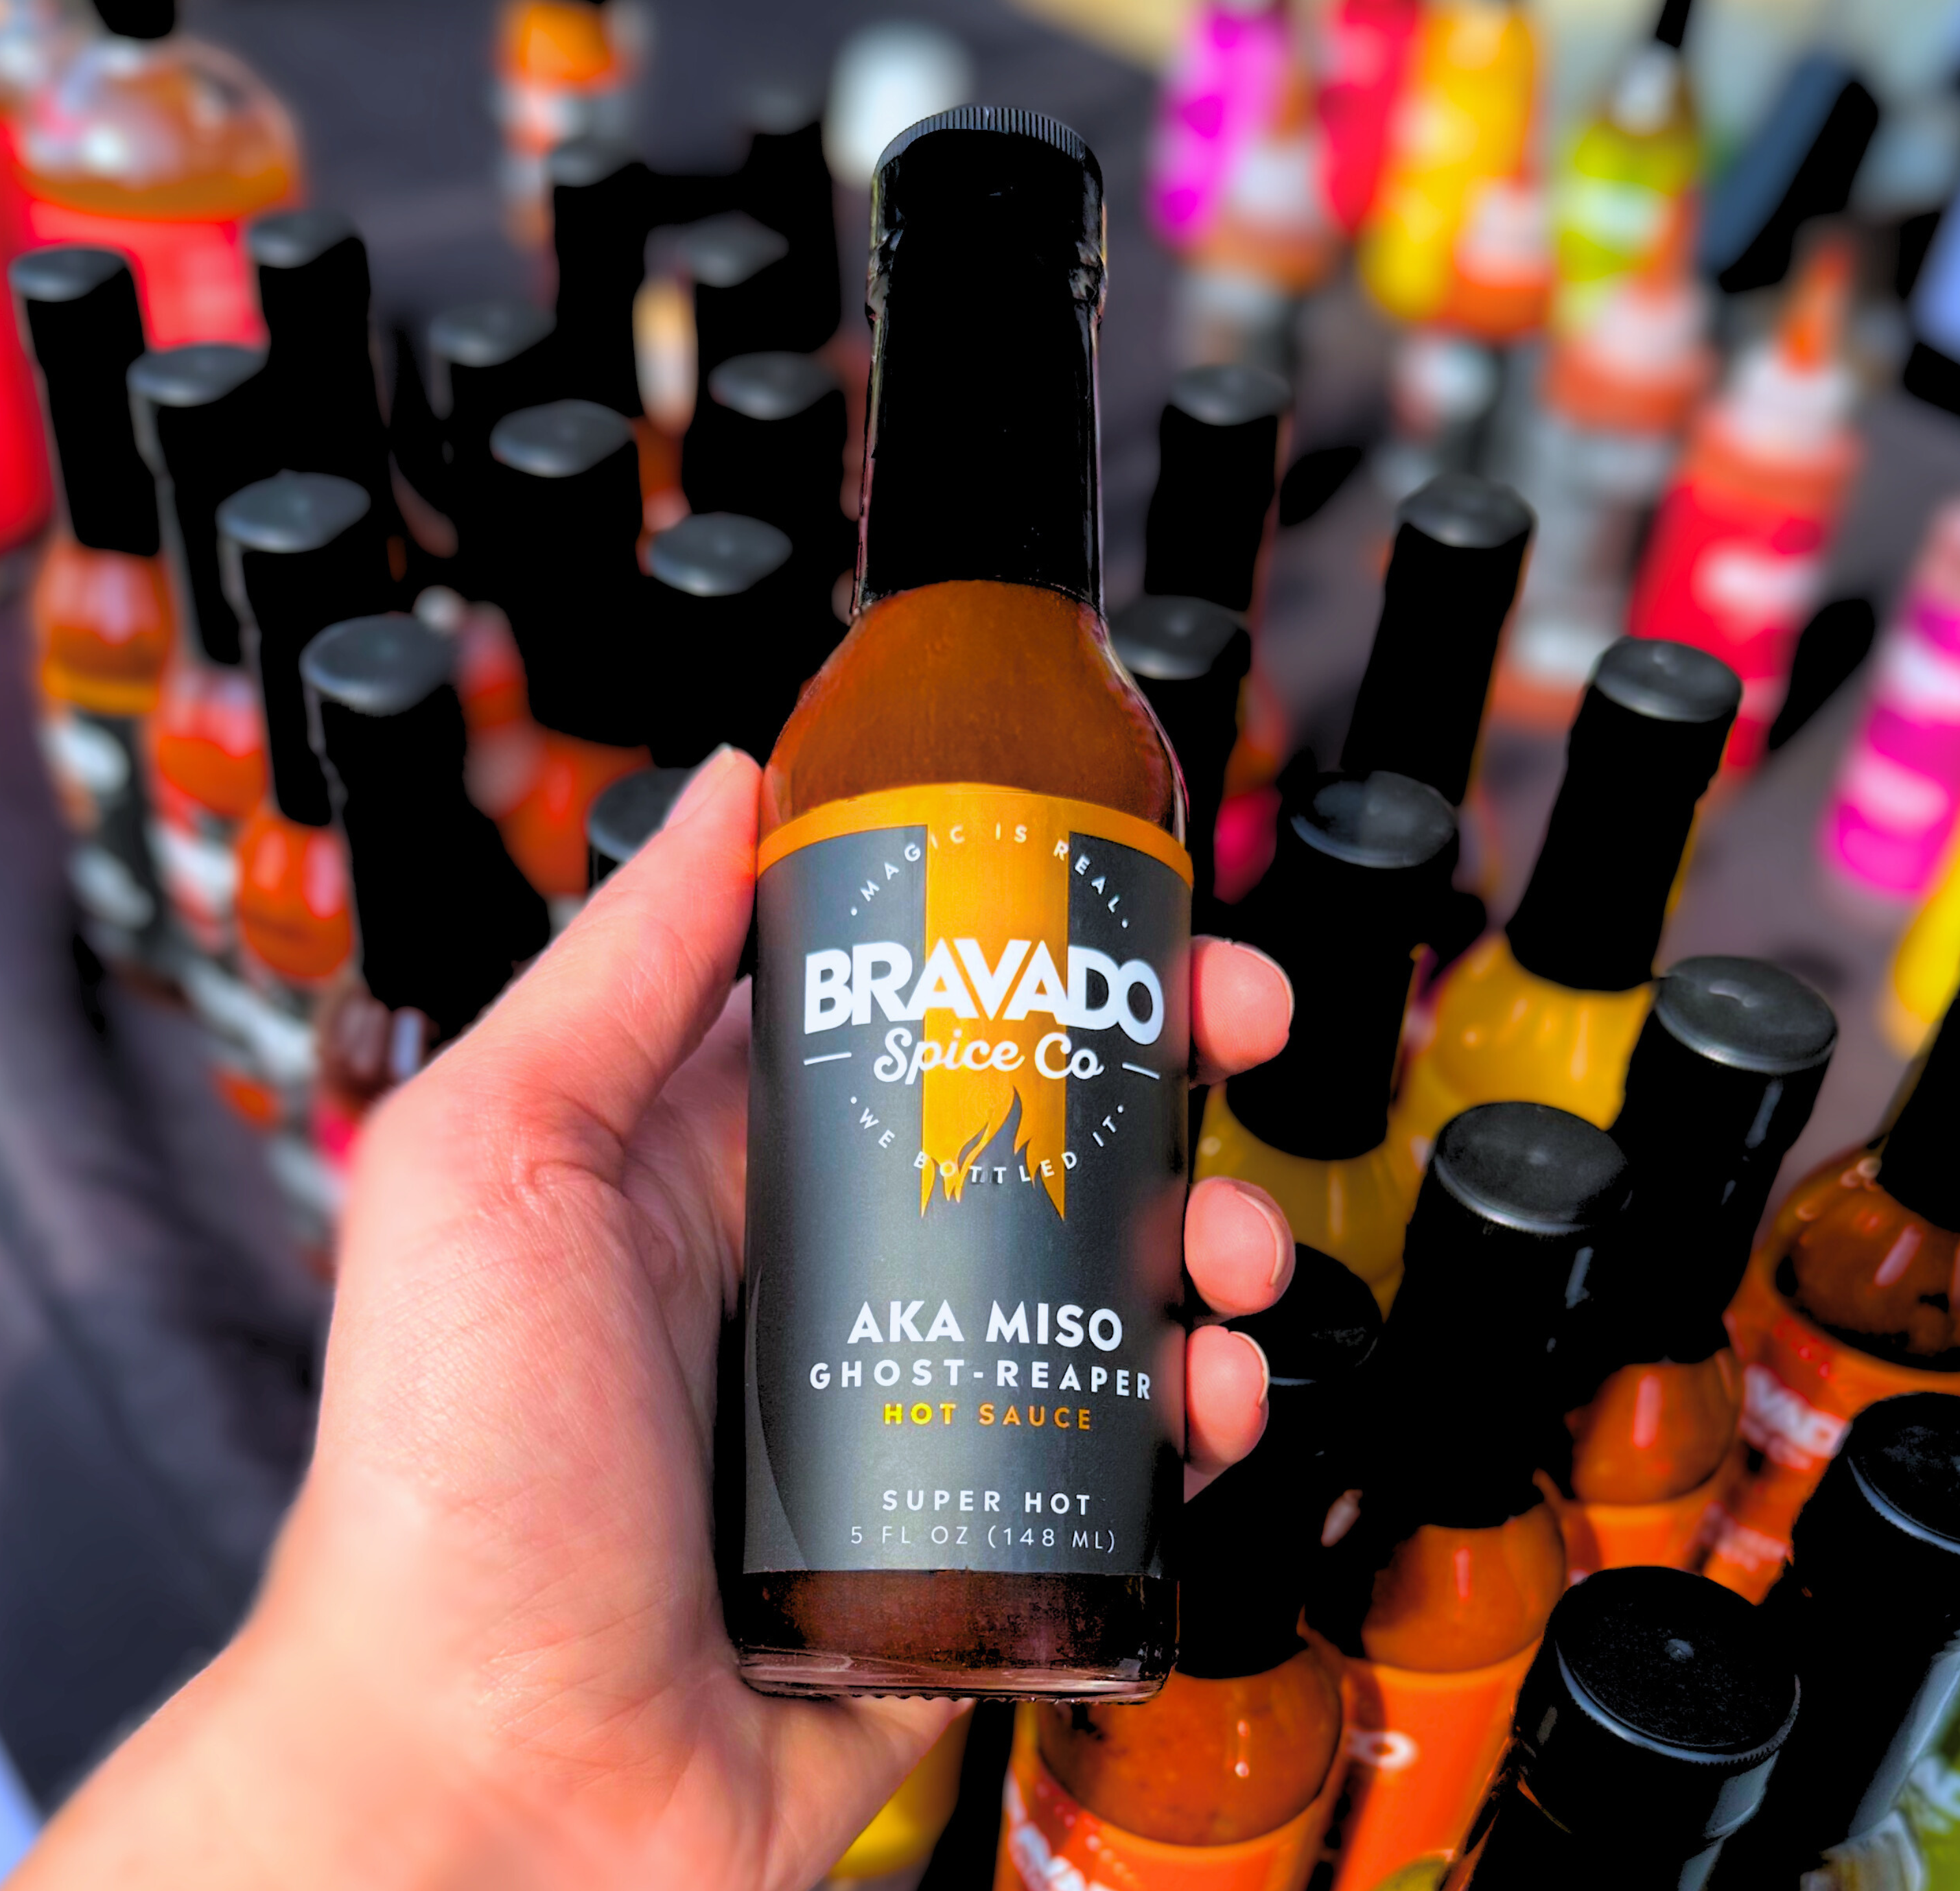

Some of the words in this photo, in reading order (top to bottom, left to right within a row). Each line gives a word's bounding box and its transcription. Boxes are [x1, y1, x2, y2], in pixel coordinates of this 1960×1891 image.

[860, 826, 964, 902] MAGIC
[996, 823, 1028, 843] IS
[1053, 840, 1120, 913] REAL
[804, 937, 1164, 1045] BRAVADO
[873, 1027, 1025, 1085] Spice
[1034, 1032, 1104, 1080] Co
[859, 1107, 896, 1148] WE
[913, 1151, 1078, 1184] BOTTLED
[1092, 1115, 1117, 1147] IT
[846, 1298, 965, 1345] AKA
[985, 1299, 1123, 1352] MISO
[809, 1358, 1150, 1400] GHOST-REAPER
[883, 1402, 957, 1426] HOT
[978, 1403, 1091, 1430] SAUCE
[881, 1489, 1001, 1512] SUPER
[1024, 1492, 1091, 1516] HOT
[850, 1525, 863, 1544] 5
[882, 1525, 911, 1544] FL
[931, 1525, 969, 1545] OZ
[986, 1525, 1055, 1549] (148
[1071, 1530, 1116, 1553] ML)
